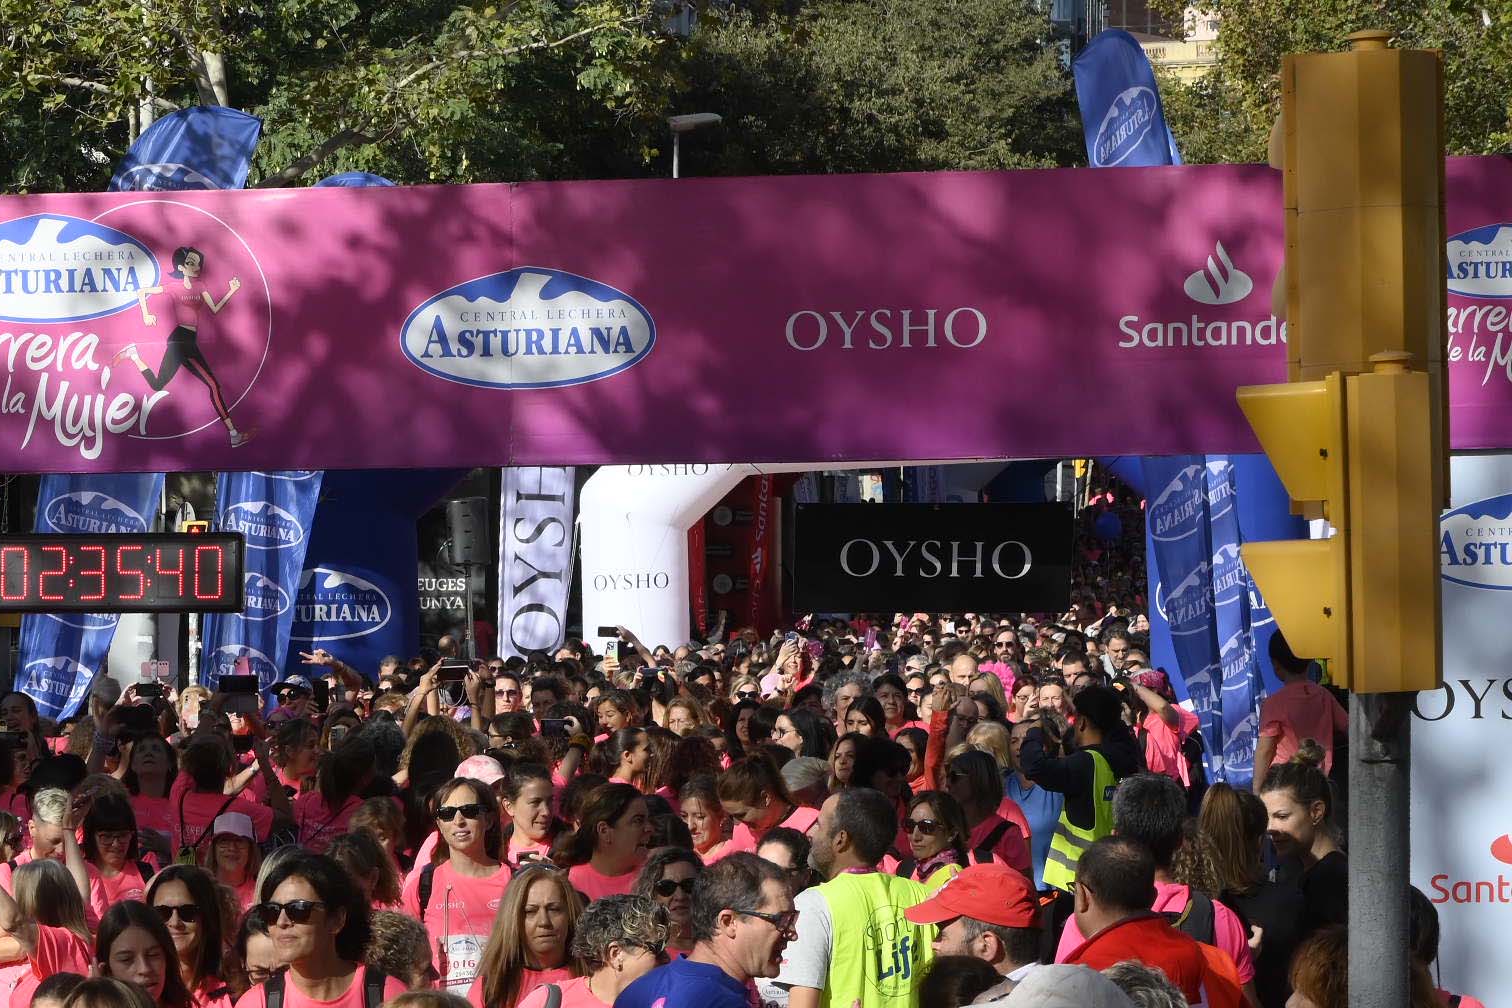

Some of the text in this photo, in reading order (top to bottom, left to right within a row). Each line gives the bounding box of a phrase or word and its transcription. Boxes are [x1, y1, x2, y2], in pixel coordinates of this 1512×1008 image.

[63, 249, 136, 261] LECHERA
[1459, 249, 1512, 258] CENTRAL
[459, 307, 627, 323] CENTRAL LECHERA
[785, 306, 988, 351] OYSHO
[420, 314, 636, 358] ASTURIANA
[1468, 334, 1487, 362] la
[0, 374, 26, 415] la
[20, 366, 170, 460] Mujer
[226, 512, 295, 542] ASTURIANA
[0, 545, 223, 600] 02:35:40
[839, 538, 1033, 579] OYSHO
[592, 573, 670, 591] OYSHO
[452, 959, 476, 969] 016
